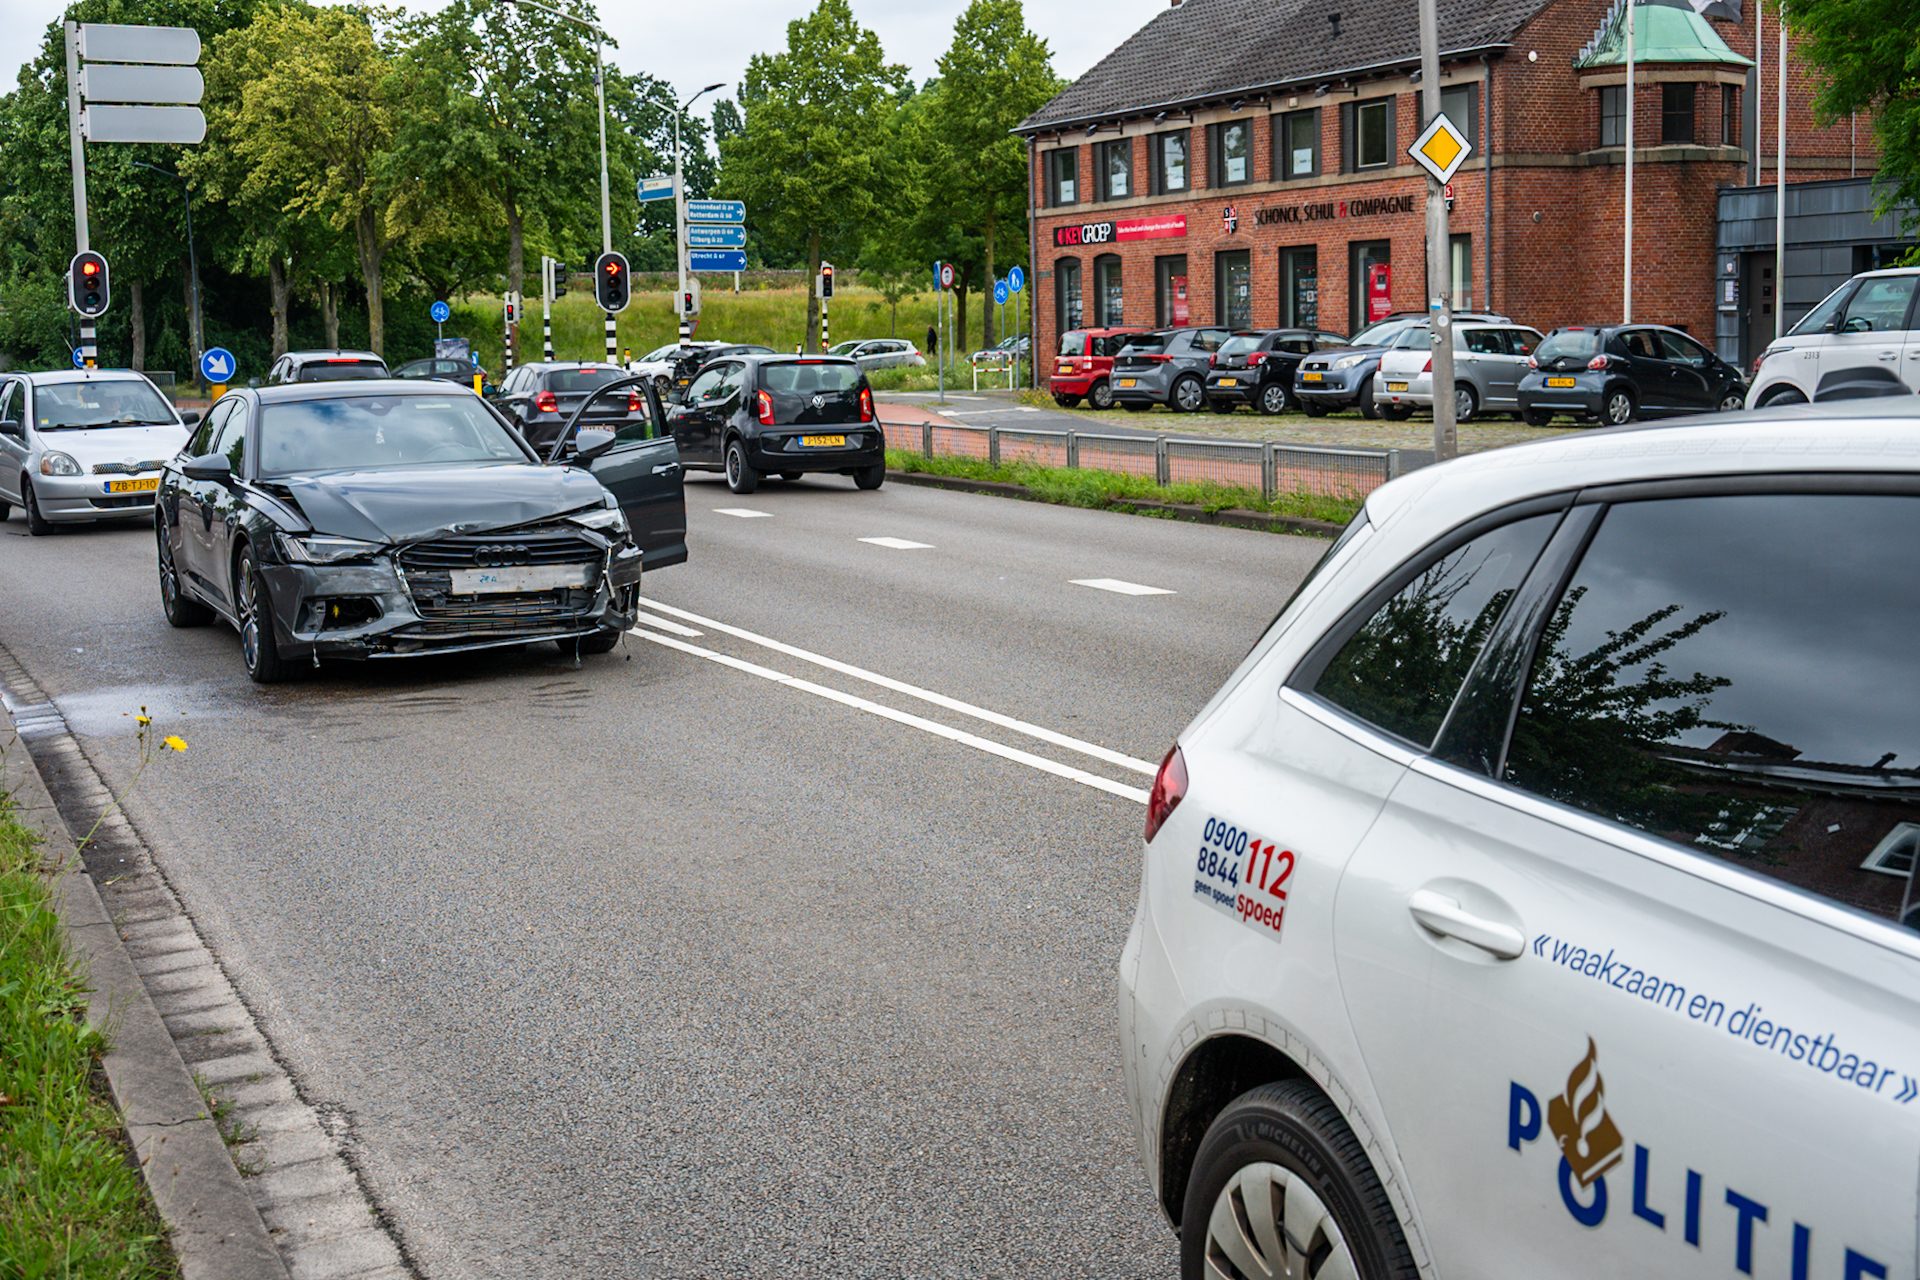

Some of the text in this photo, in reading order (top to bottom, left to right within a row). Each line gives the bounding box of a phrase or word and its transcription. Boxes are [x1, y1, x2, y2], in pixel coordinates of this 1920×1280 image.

[1255, 206, 1302, 225] SCHONCK,
[1304, 203, 1335, 221] SCHUL
[1351, 196, 1416, 216] COMPAGNIE
[115, 480, 156, 492] ZB-TJ-10
[1204, 817, 1248, 856] 0900
[1197, 847, 1239, 888] 8844
[1246, 838, 1295, 901] 112
[1194, 879, 1236, 908] geen spoed
[1236, 893, 1284, 932] spoed
[1688, 994, 1725, 1027] en
[1258, 1122, 1321, 1172] MICHELIN
